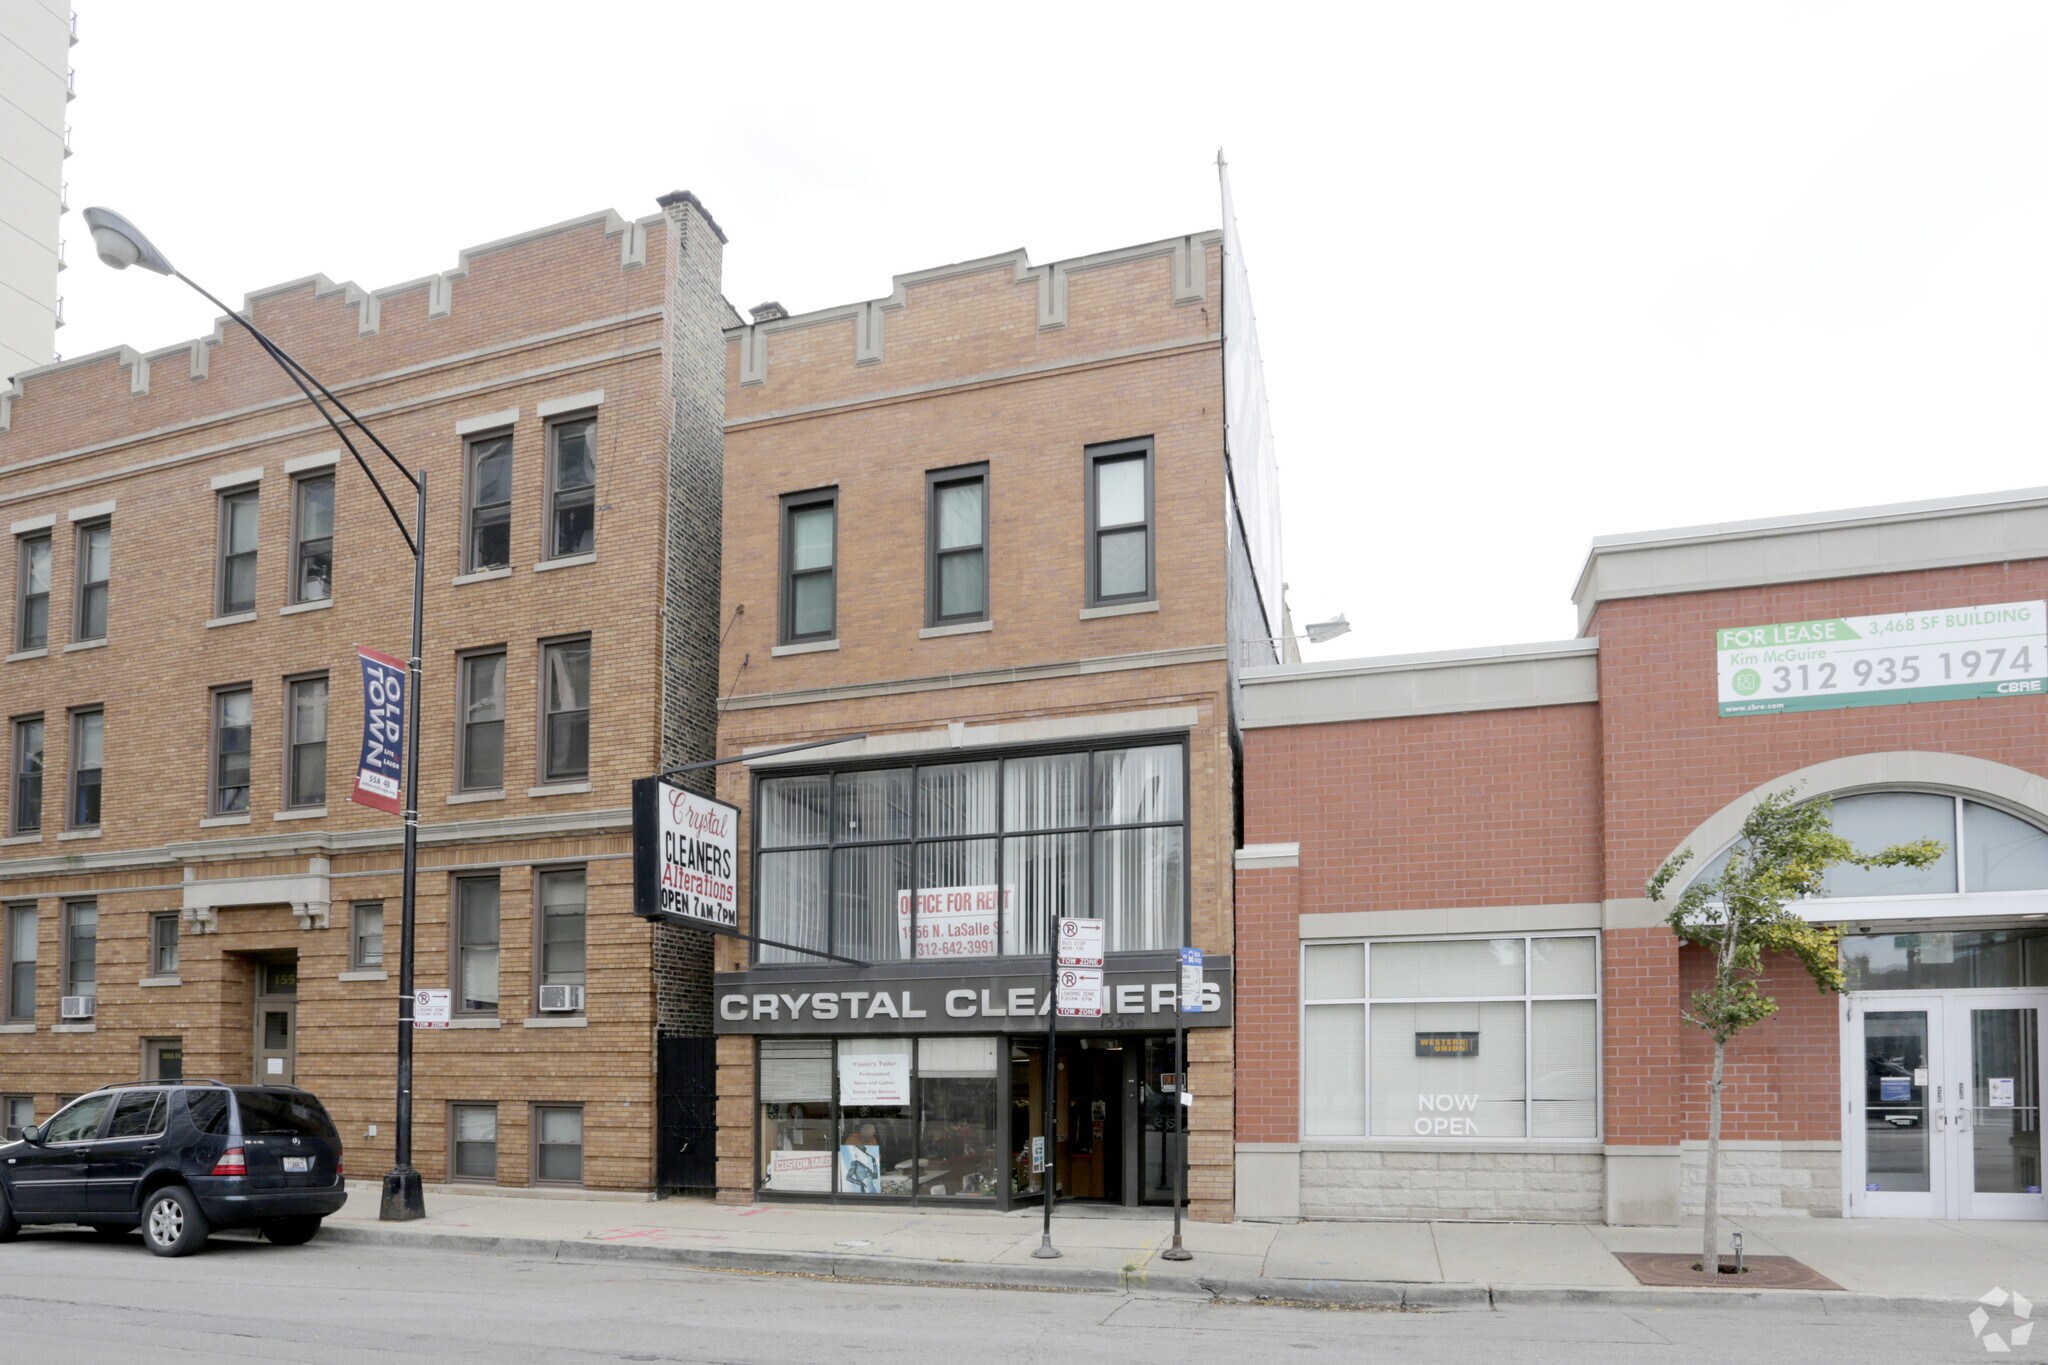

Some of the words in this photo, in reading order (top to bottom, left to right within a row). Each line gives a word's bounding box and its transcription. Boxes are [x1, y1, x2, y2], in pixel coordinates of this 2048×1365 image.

[1869, 618, 1915, 636] 3,468
[1921, 616, 1940, 630] SF
[1946, 607, 2031, 627] BUILDING
[1723, 629, 1766, 648] FOR
[1774, 622, 1836, 643] LEASE
[1730, 653, 1758, 666] Kim
[1763, 648, 1827, 663] McGuire
[1772, 662, 1837, 693] 312
[1853, 655, 1920, 687] 935
[1939, 646, 2033, 680] 1974
[1996, 680, 2041, 693] CBRE
[385, 676, 401, 743] OLD
[1725, 703, 1785, 713] www.cbre.com
[366, 667, 385, 769] TOWN
[383, 758, 399, 770] LAUGH
[369, 774, 381, 785] SSA
[668, 789, 729, 838] Crystal
[665, 830, 731, 879] CLEANERS
[662, 863, 734, 902] Alterations
[661, 887, 690, 914] OPEN
[947, 892, 972, 912] FOR
[902, 925, 929, 939] 156
[932, 924, 944, 938] N.
[948, 922, 990, 937] LaSalle
[917, 940, 994, 956] 312-642-3991
[1061, 957, 1077, 965] TOW
[1079, 958, 1099, 966] ZONE
[720, 991, 927, 1021] CRYSTAL
[945, 982, 1221, 1018] CLEERS
[1078, 1008, 1098, 1016] ZONE
[1101, 1015, 1136, 1029] 1556
[1420, 1038, 1467, 1046] WESTERN
[1418, 1094, 1479, 1111] NOW
[776, 1159, 809, 1170] CUSTOM
